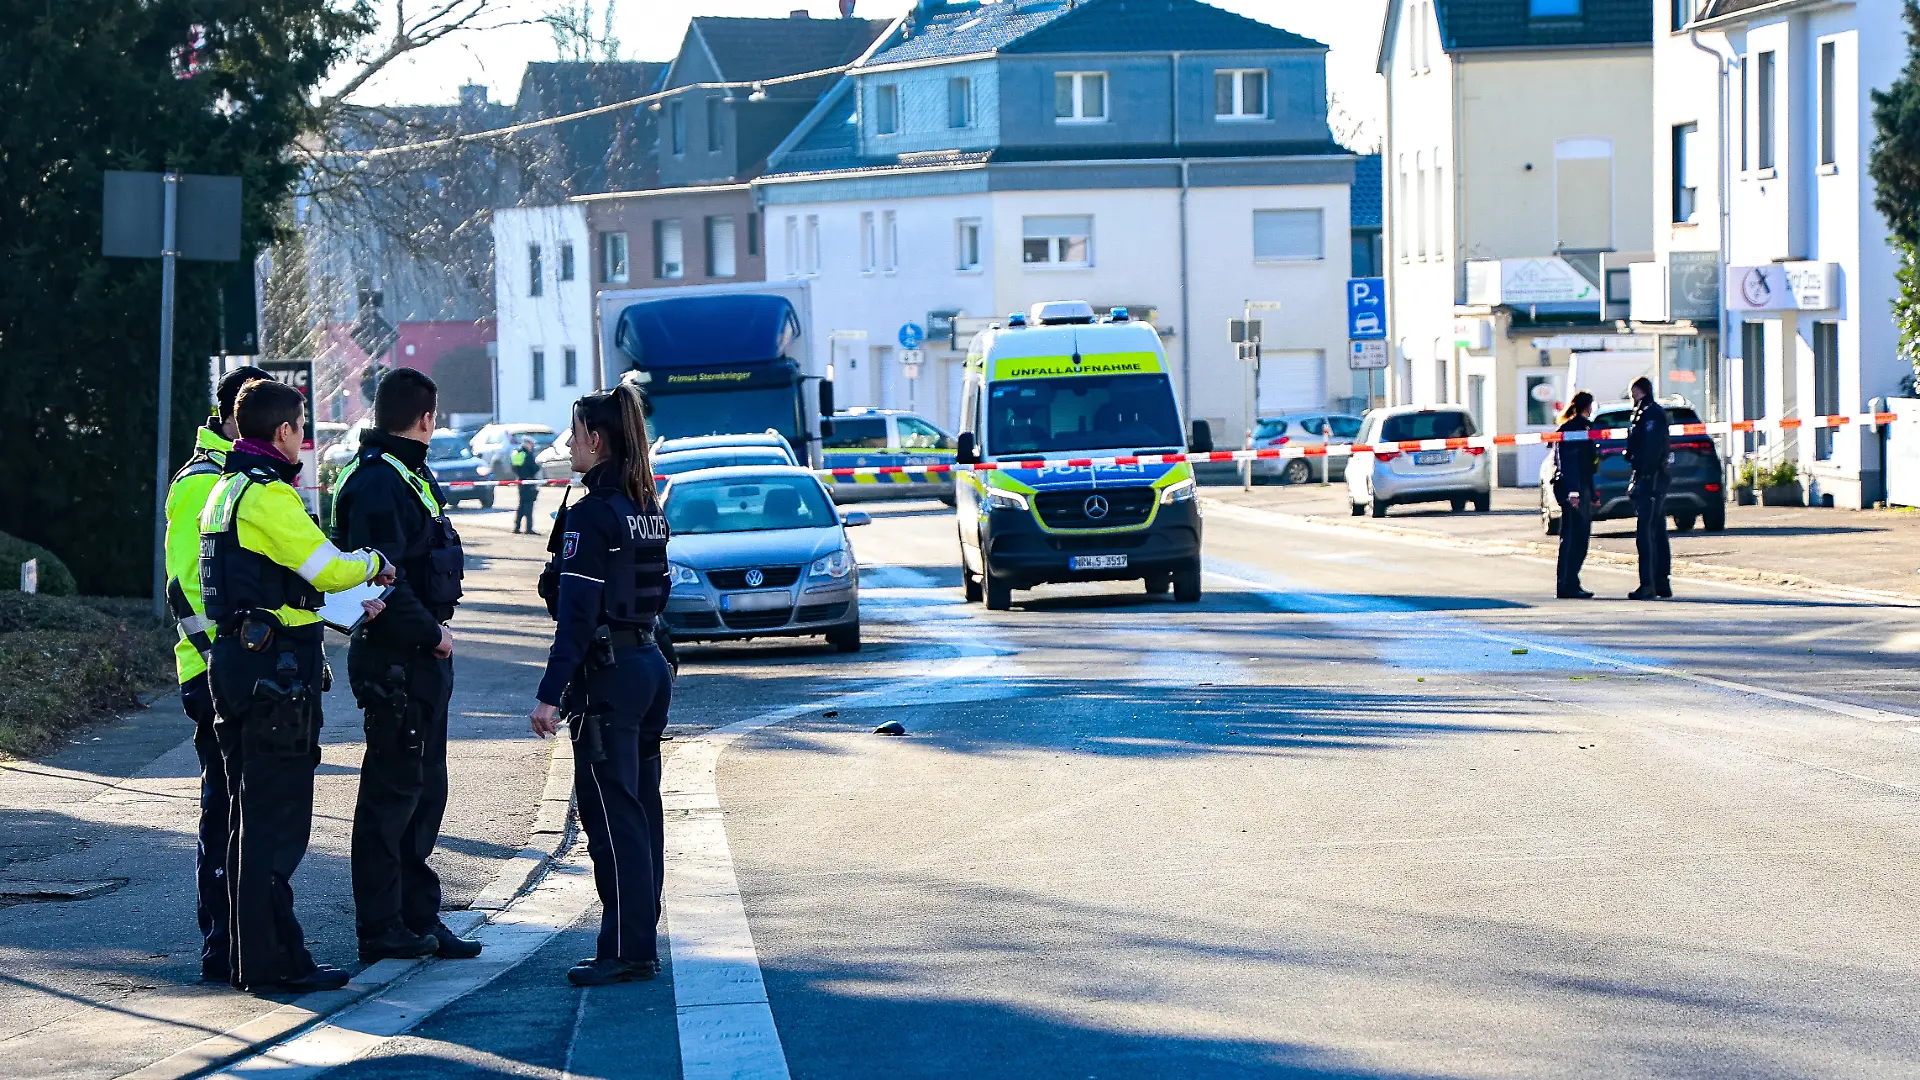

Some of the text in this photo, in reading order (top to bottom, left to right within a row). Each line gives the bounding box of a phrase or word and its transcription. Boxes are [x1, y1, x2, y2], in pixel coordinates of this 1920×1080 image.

[1353, 282, 1370, 307] P
[1011, 363, 1141, 376] UNFALLAUFNAHME
[667, 374, 697, 384] Primus
